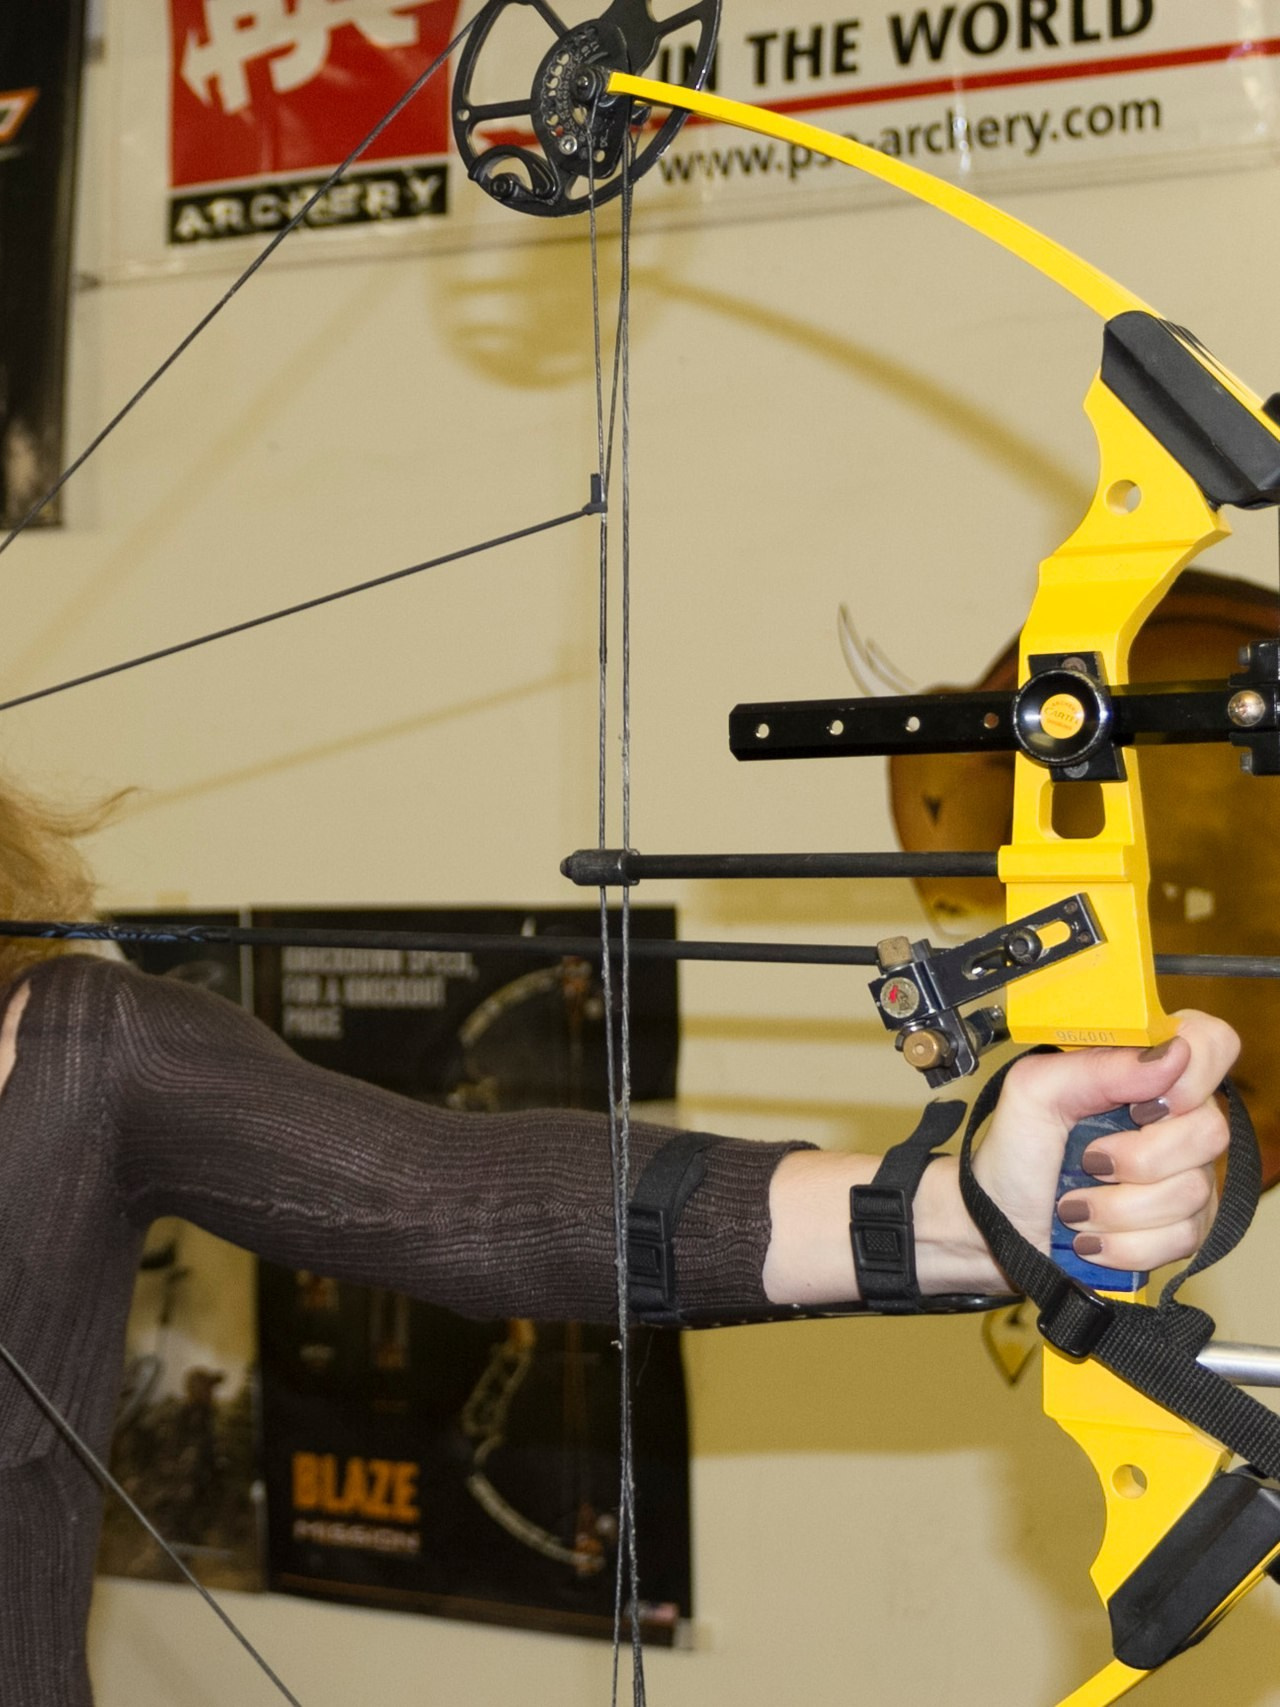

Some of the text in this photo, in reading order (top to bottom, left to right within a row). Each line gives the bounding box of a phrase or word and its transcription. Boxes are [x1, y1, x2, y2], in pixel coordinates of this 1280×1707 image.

[744, 19, 861, 87] THE
[887, 0, 1156, 67] WORLD
[173, 171, 443, 240] ARCHERY
[292, 1452, 420, 1524] BLAZE
